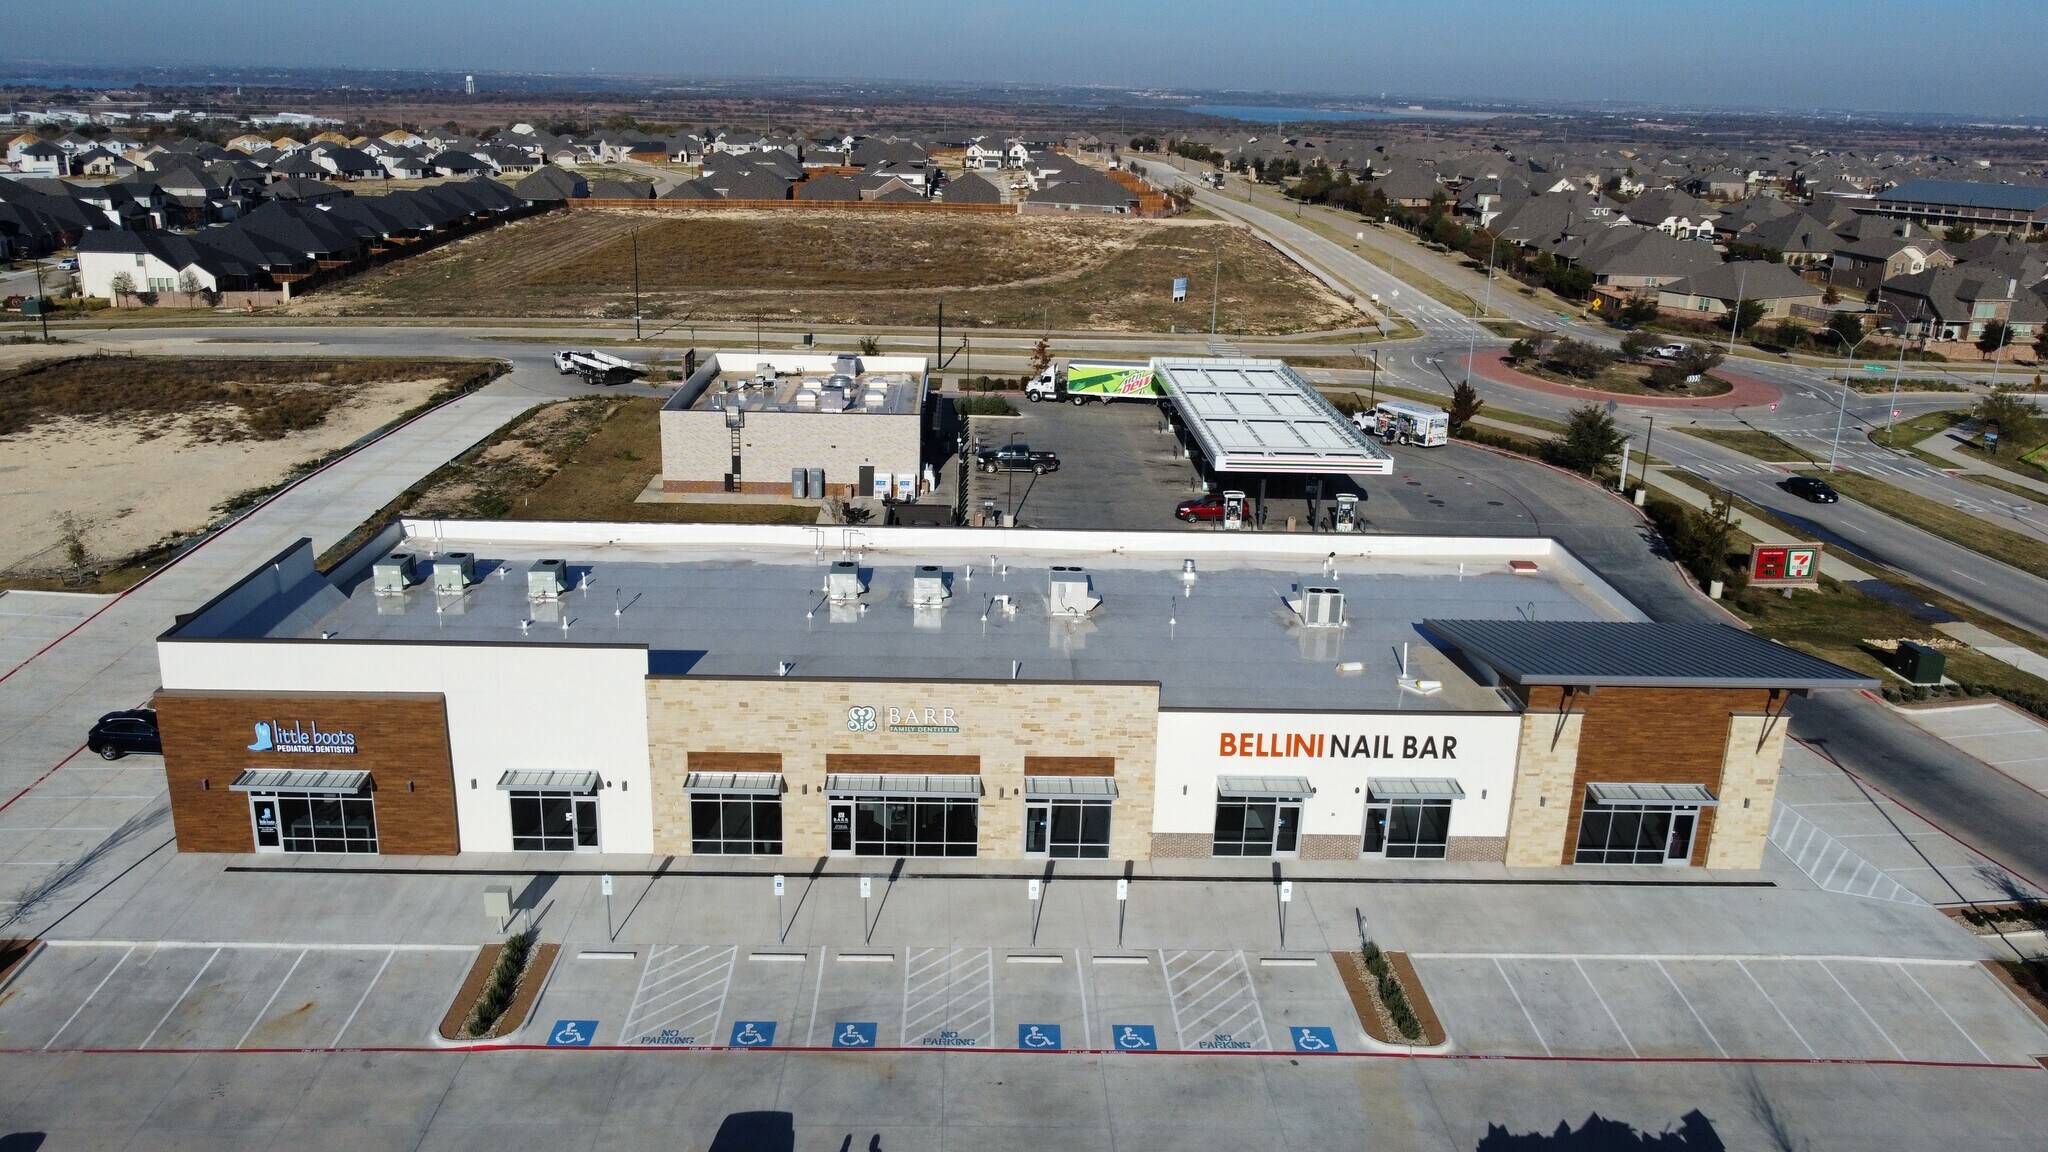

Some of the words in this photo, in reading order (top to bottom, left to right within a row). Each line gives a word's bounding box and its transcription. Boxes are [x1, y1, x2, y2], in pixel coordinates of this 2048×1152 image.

[889, 706, 959, 725] BARR
[273, 719, 310, 744] little
[312, 720, 355, 745] boots
[277, 744, 314, 753] PEDIATRIC
[315, 745, 355, 753] DENTISTRY
[1219, 732, 1325, 758] BELLINI
[1329, 734, 1394, 759] NAIL
[1402, 735, 1458, 760] BAR
[661, 1029, 680, 1037] NO
[640, 1036, 695, 1044] PARKING
[922, 1038, 976, 1046] PARKING
[1214, 1034, 1232, 1042] NO
[1199, 1041, 1251, 1049] PARKING
